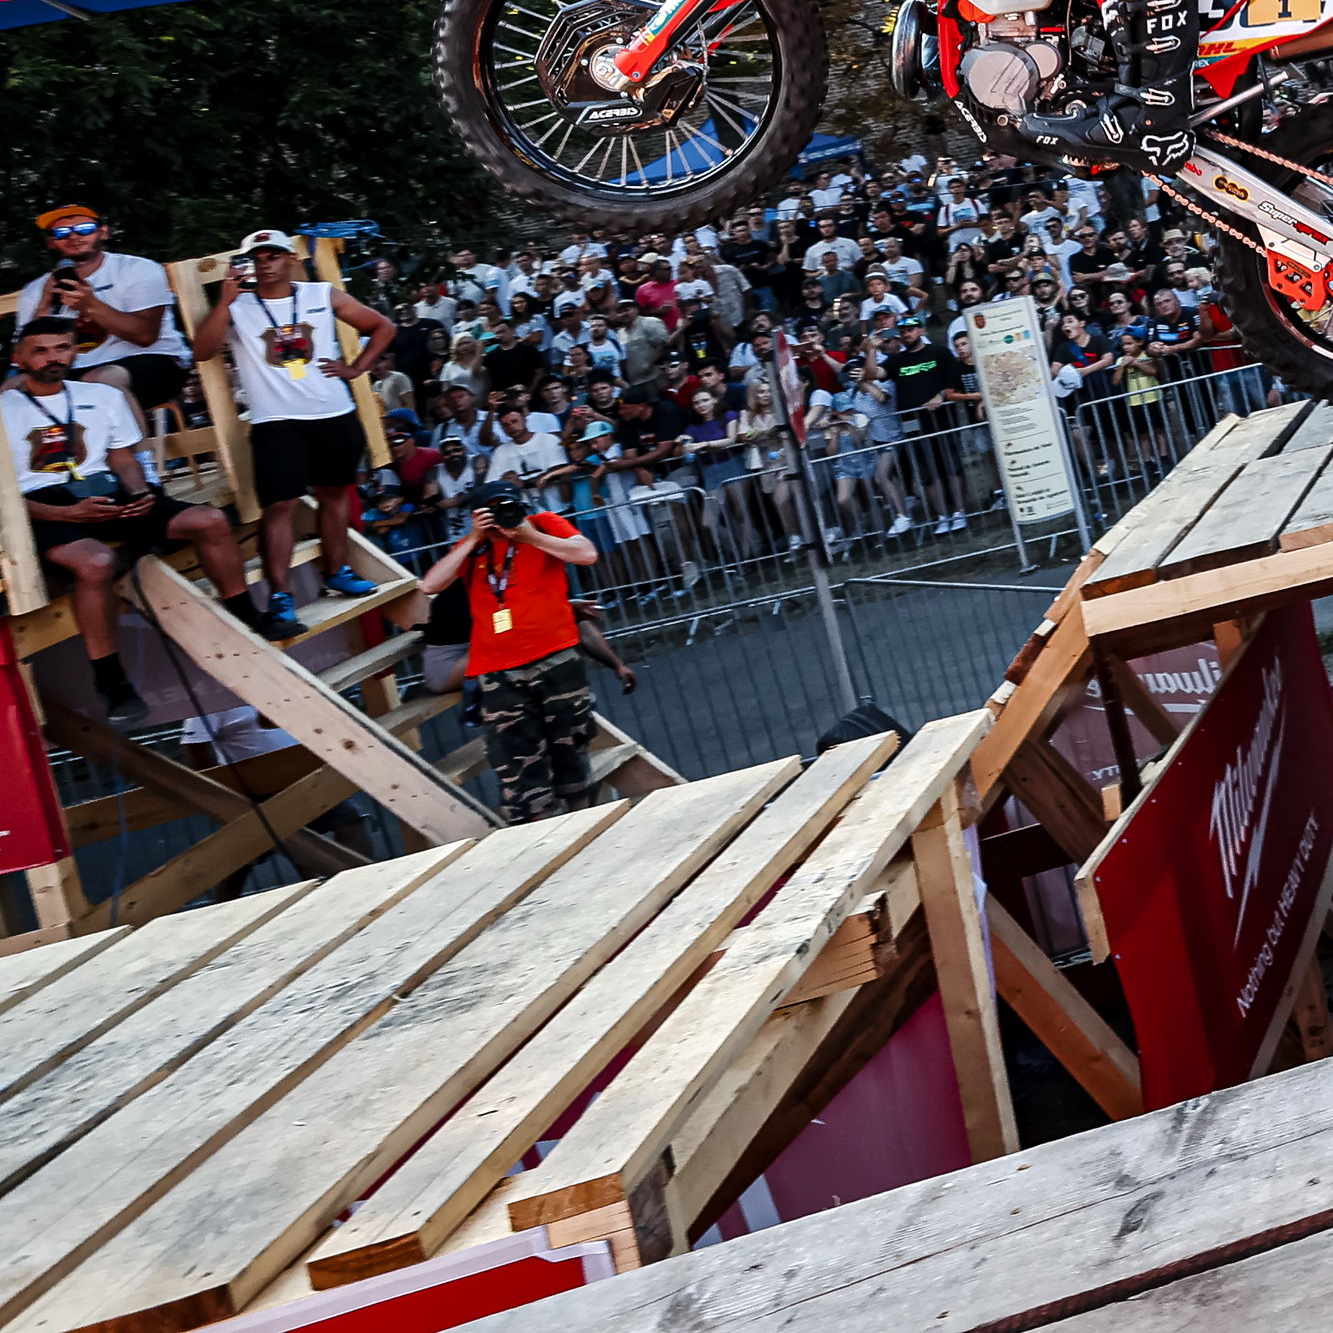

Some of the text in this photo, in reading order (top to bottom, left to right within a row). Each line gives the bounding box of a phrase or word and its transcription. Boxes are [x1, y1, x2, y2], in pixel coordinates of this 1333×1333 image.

[1146, 10, 1188, 35] FOX
[1198, 42, 1235, 56] DHL
[1035, 135, 1059, 145] FOX
[1237, 809, 1319, 1017] Nothing but HEAVY DUTY
